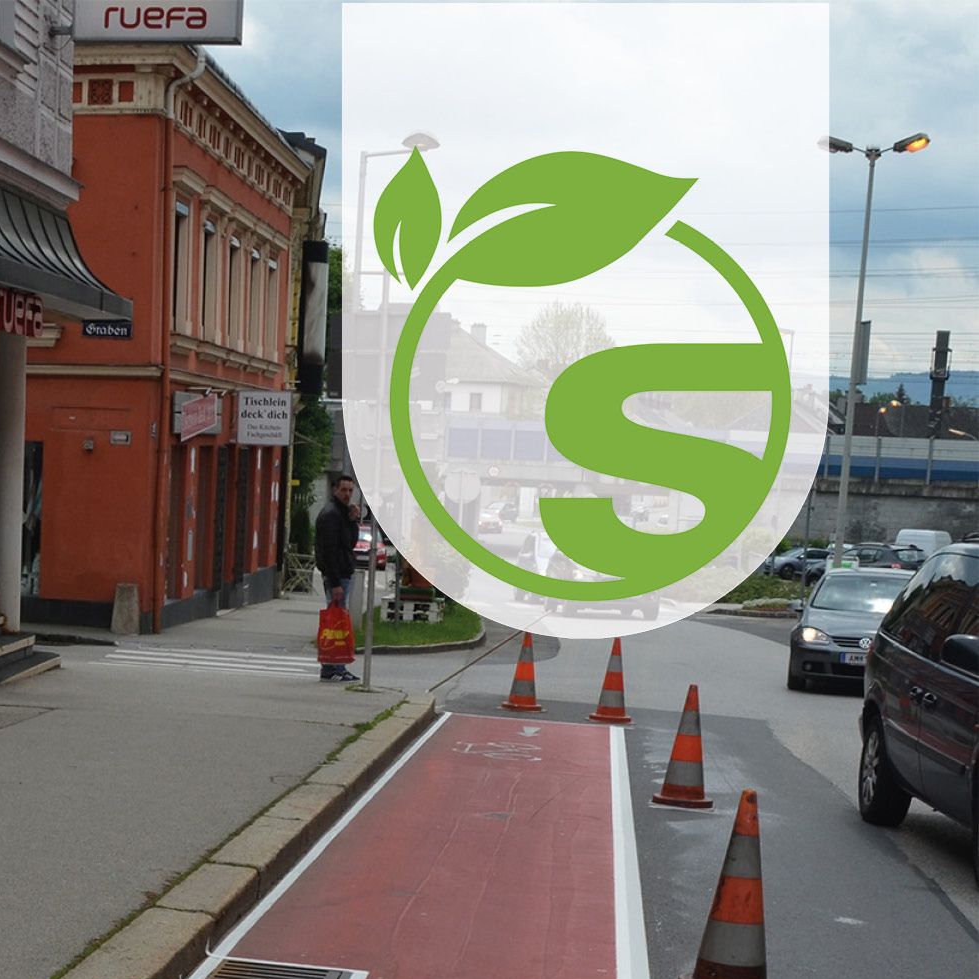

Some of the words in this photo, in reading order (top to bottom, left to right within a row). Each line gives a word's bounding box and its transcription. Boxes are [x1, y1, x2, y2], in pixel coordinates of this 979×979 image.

[104, 6, 207, 29] ruefa
[85, 324, 128, 336] Graben
[243, 397, 287, 406] Tischlein
